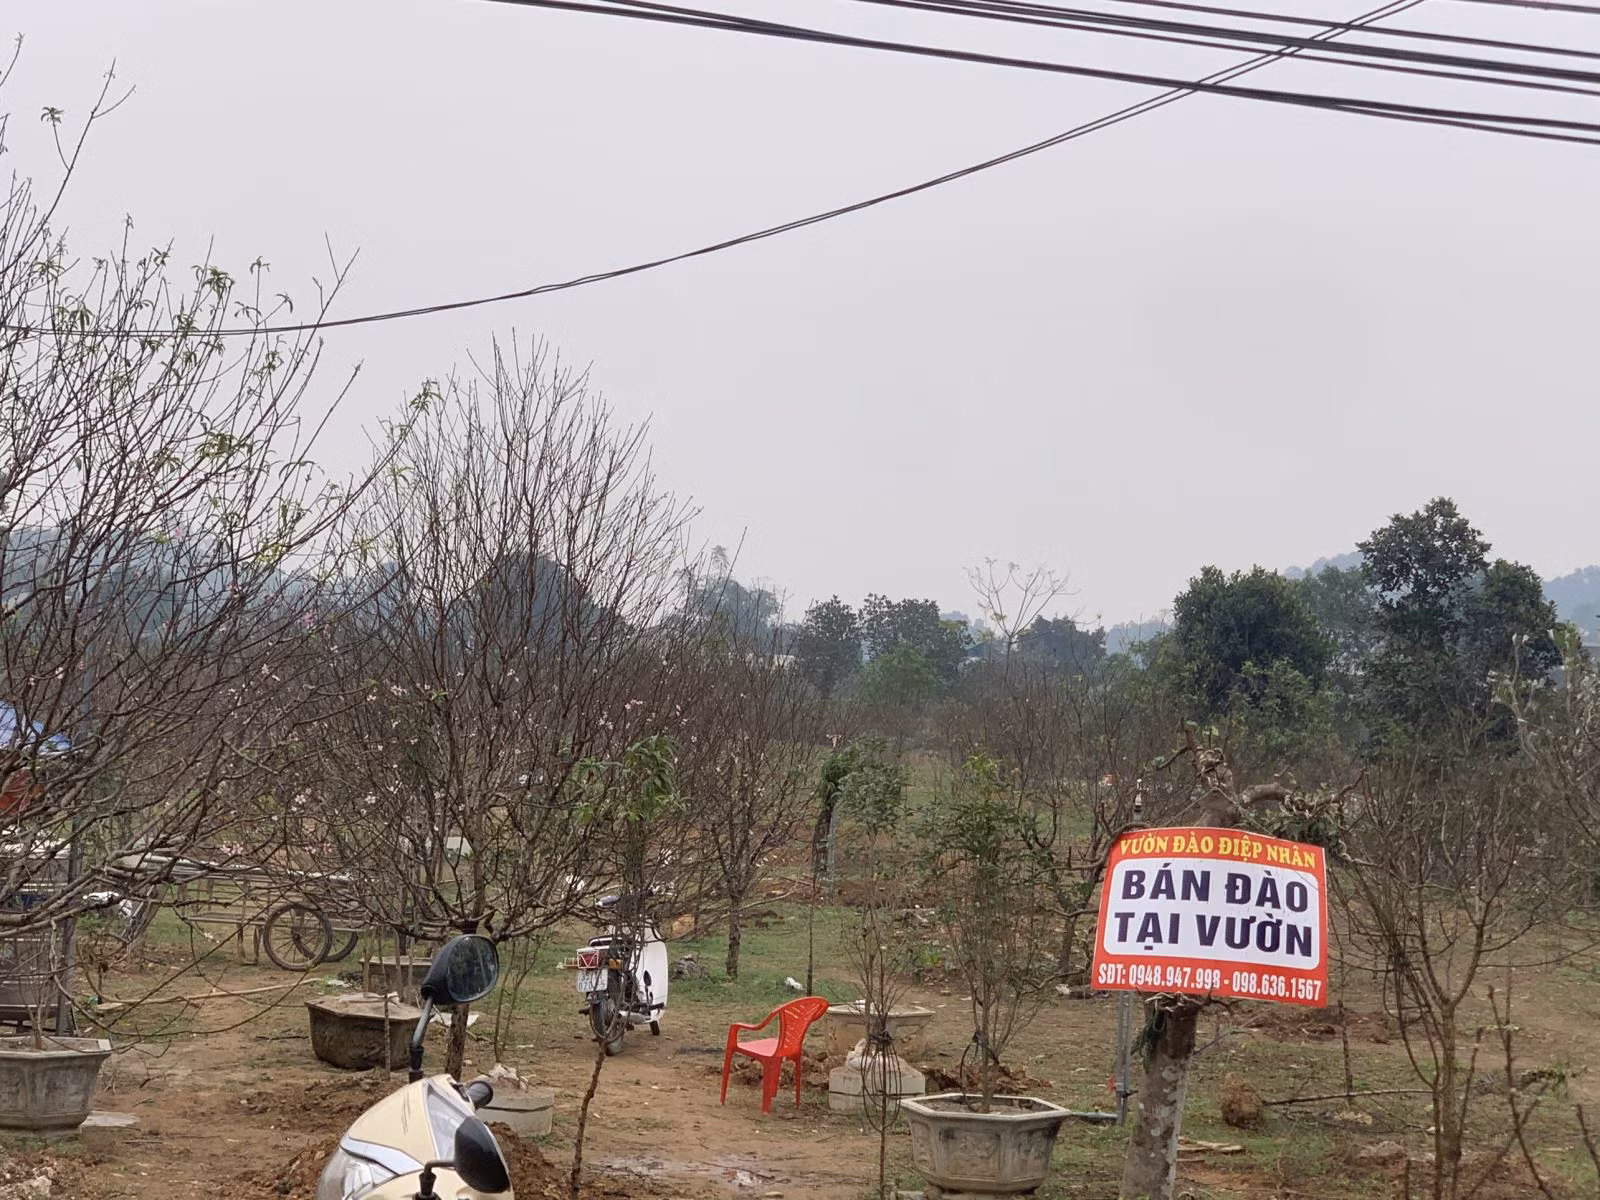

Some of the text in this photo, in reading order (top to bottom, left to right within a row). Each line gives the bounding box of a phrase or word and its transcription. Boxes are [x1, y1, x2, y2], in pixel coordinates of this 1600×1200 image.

[1120, 832, 1316, 868] VƯỜN ĐÀO ĐIỆP NHÂN
[1122, 863, 1309, 913] BÁN ĐÀO
[1114, 912, 1312, 958] TẠI VƯỜN
[1098, 963, 1126, 985] SĐT:
[1129, 967, 1221, 990] 0948.947.998
[1232, 971, 1322, 1001] 098.636.1567
